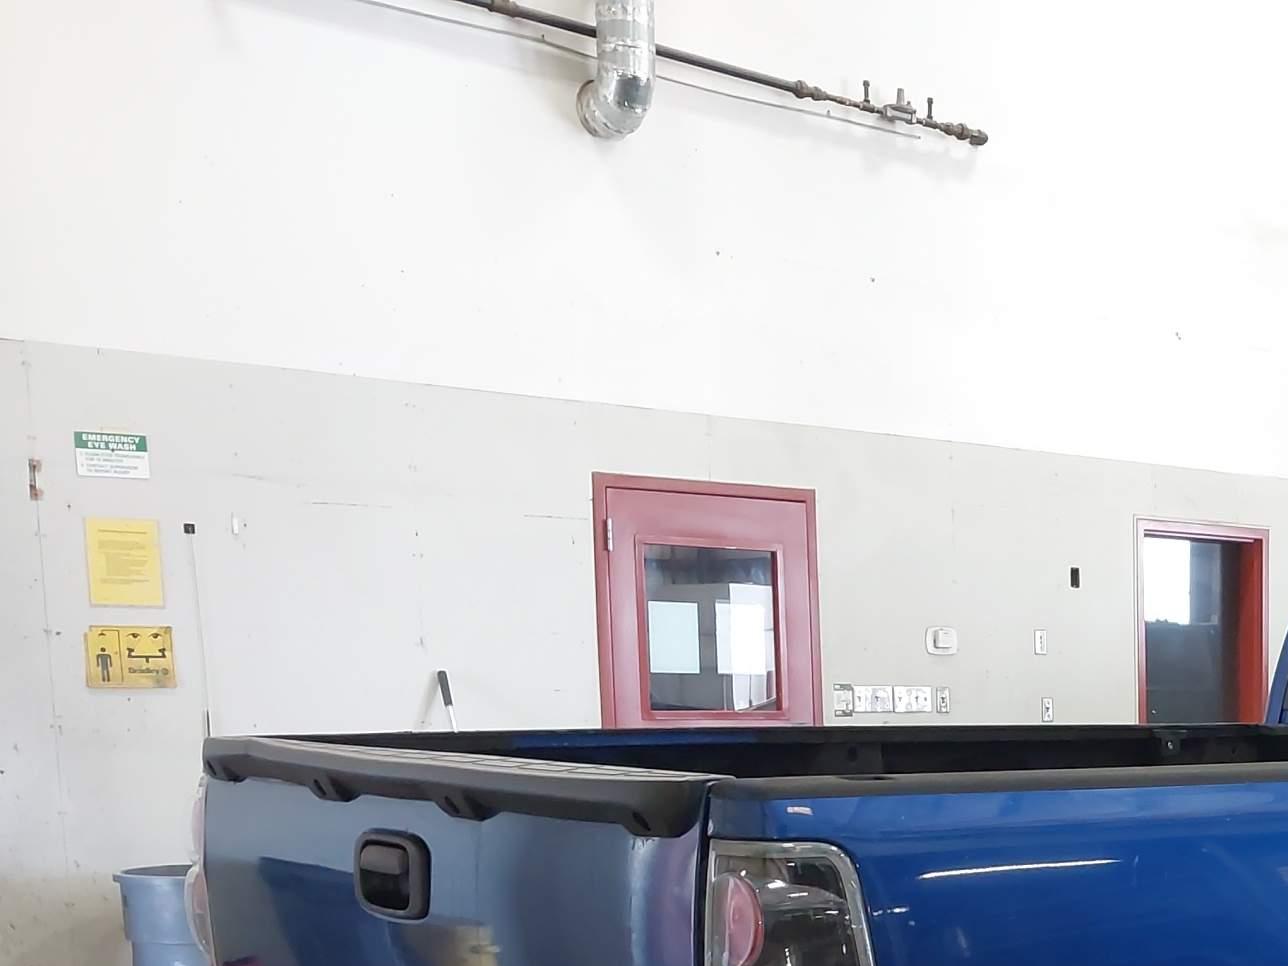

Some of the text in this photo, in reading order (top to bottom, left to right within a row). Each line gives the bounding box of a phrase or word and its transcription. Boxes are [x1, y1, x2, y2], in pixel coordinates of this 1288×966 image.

[82, 433, 140, 444] EMERGENCY
[87, 441, 137, 451] EYE WASH
